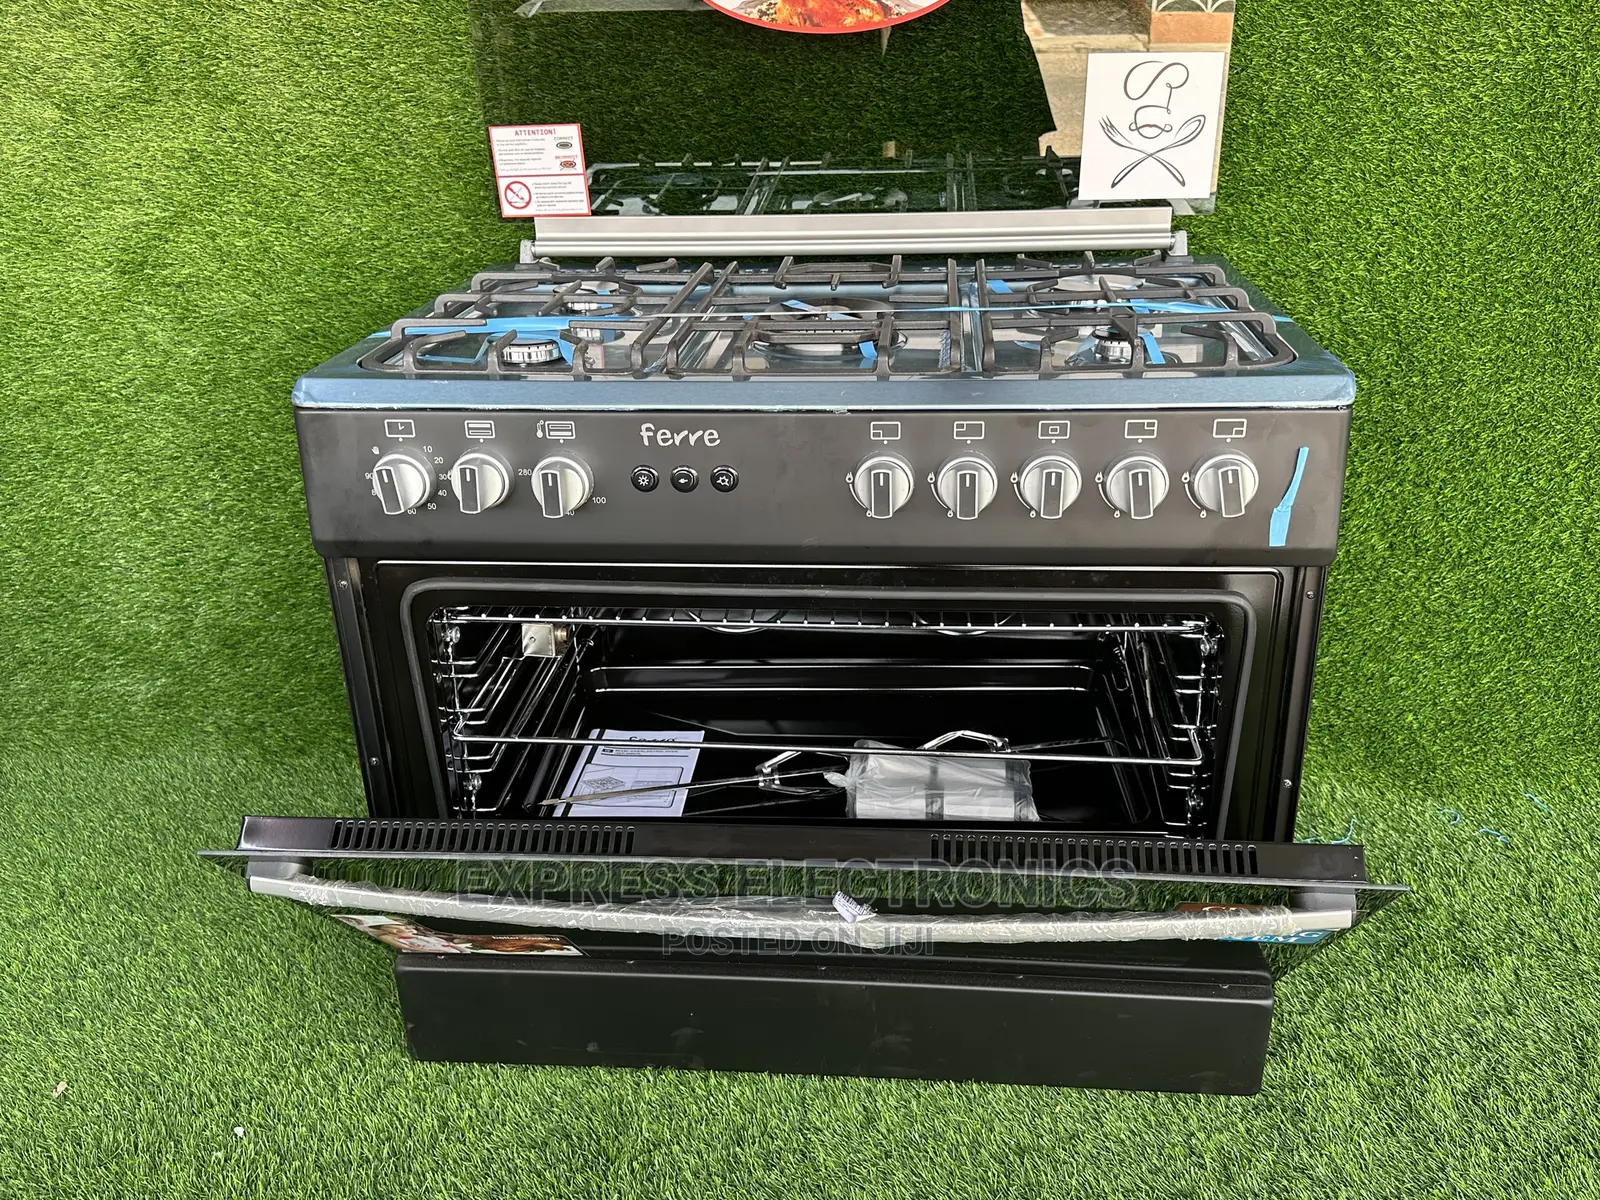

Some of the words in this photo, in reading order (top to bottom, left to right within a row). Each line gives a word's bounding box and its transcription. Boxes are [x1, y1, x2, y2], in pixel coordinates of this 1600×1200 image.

[514, 128, 557, 136] ATTENTION!
[639, 422, 721, 447] ferre
[422, 445, 433, 453] 10
[433, 456, 444, 464] 20
[364, 472, 374, 480] 90
[518, 468, 532, 476] 280
[437, 489, 447, 497] 40
[592, 496, 607, 504] 100
[427, 502, 437, 510] 50
